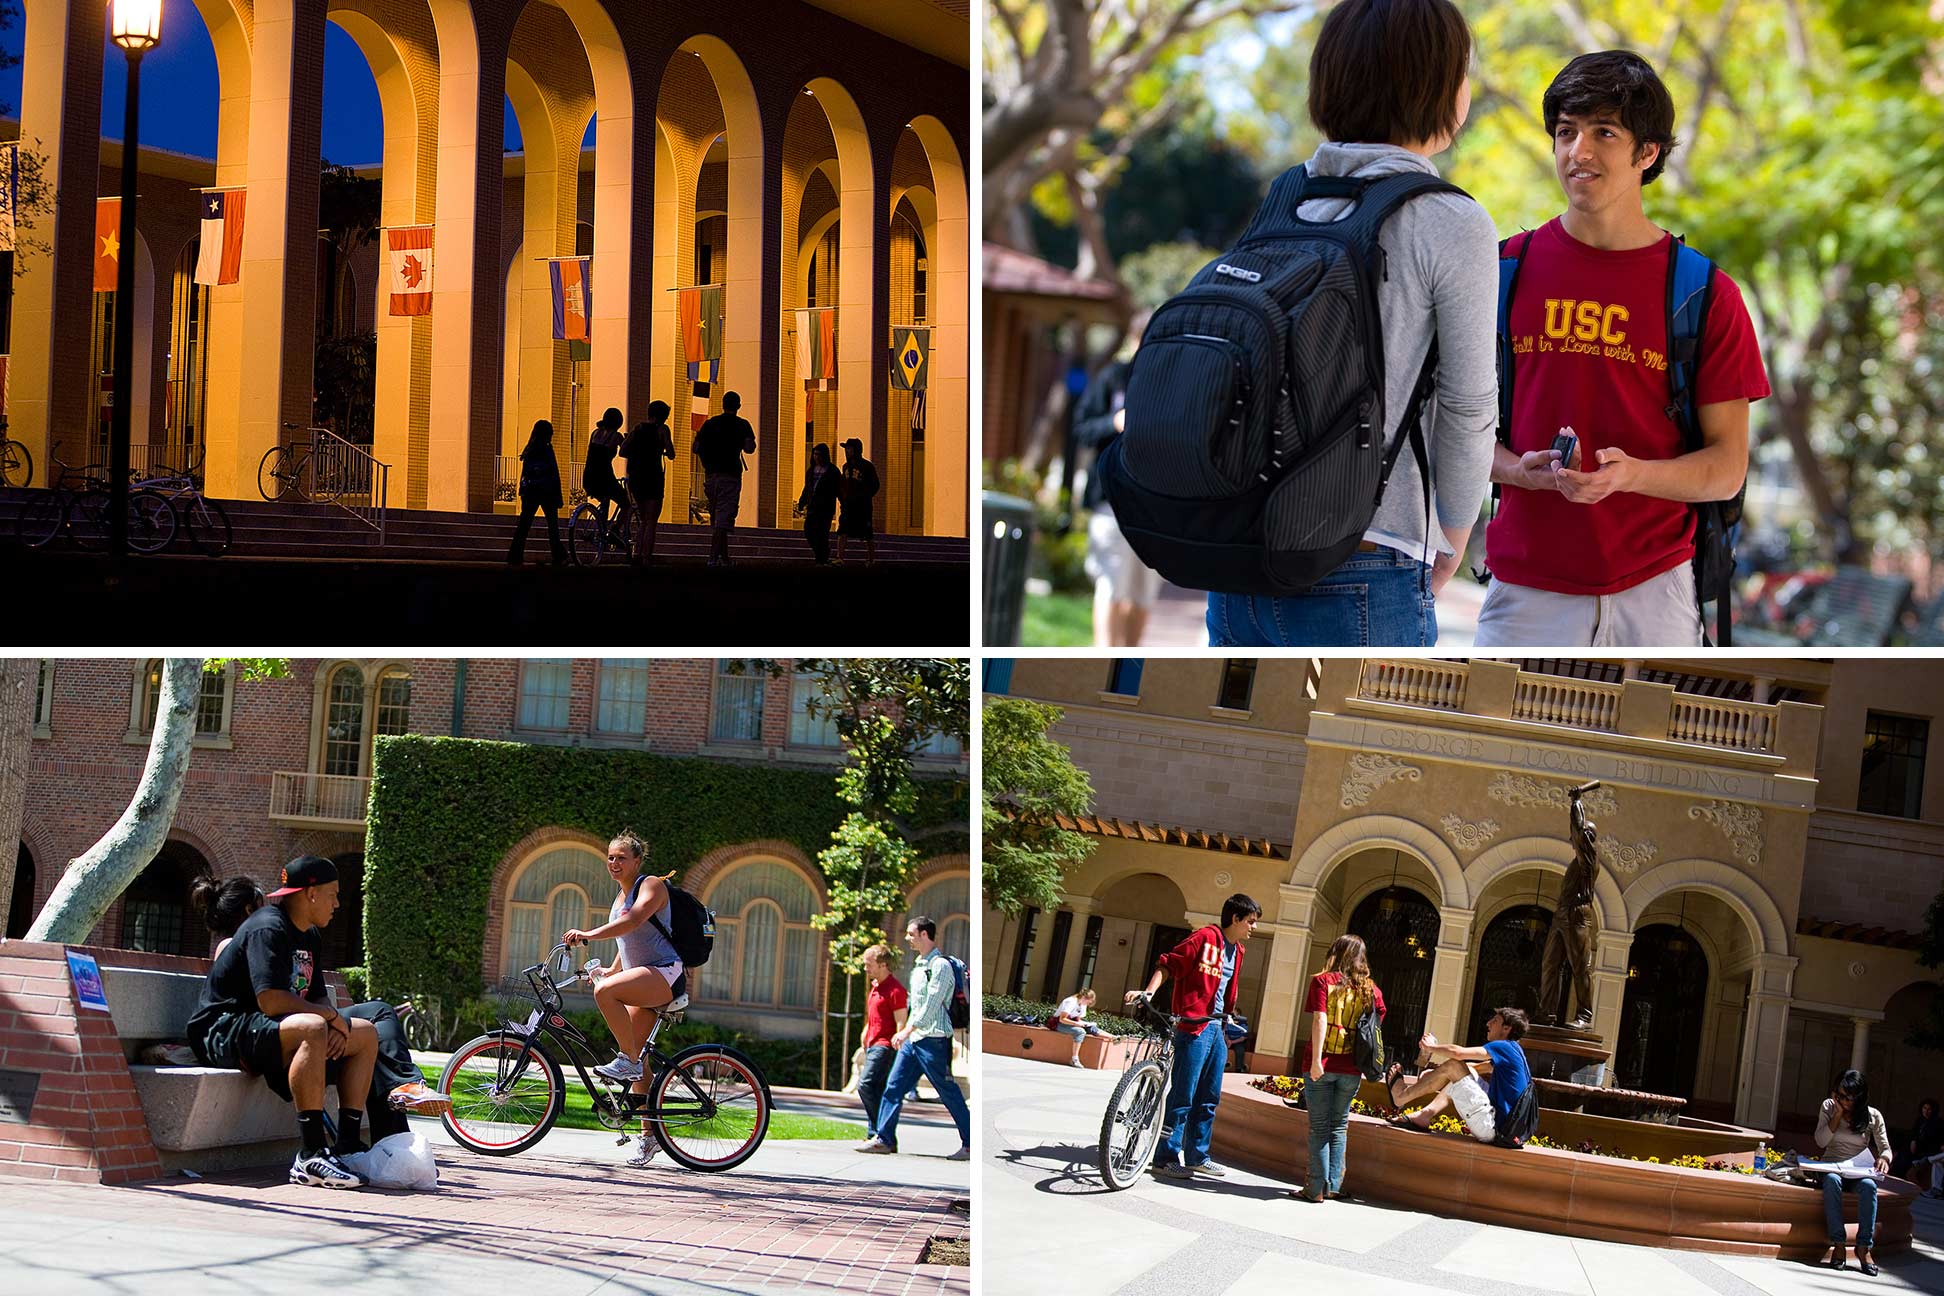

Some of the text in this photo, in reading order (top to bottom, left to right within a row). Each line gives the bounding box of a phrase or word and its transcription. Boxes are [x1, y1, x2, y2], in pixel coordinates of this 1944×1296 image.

[1216, 264, 1261, 282] OGIO
[1545, 299, 1629, 345] USC
[1538, 334, 1553, 352] in
[1559, 335, 1600, 355] Love
[1603, 344, 1636, 363] with
[1380, 728, 1742, 795] GEORGE LUCAS BUILDING
